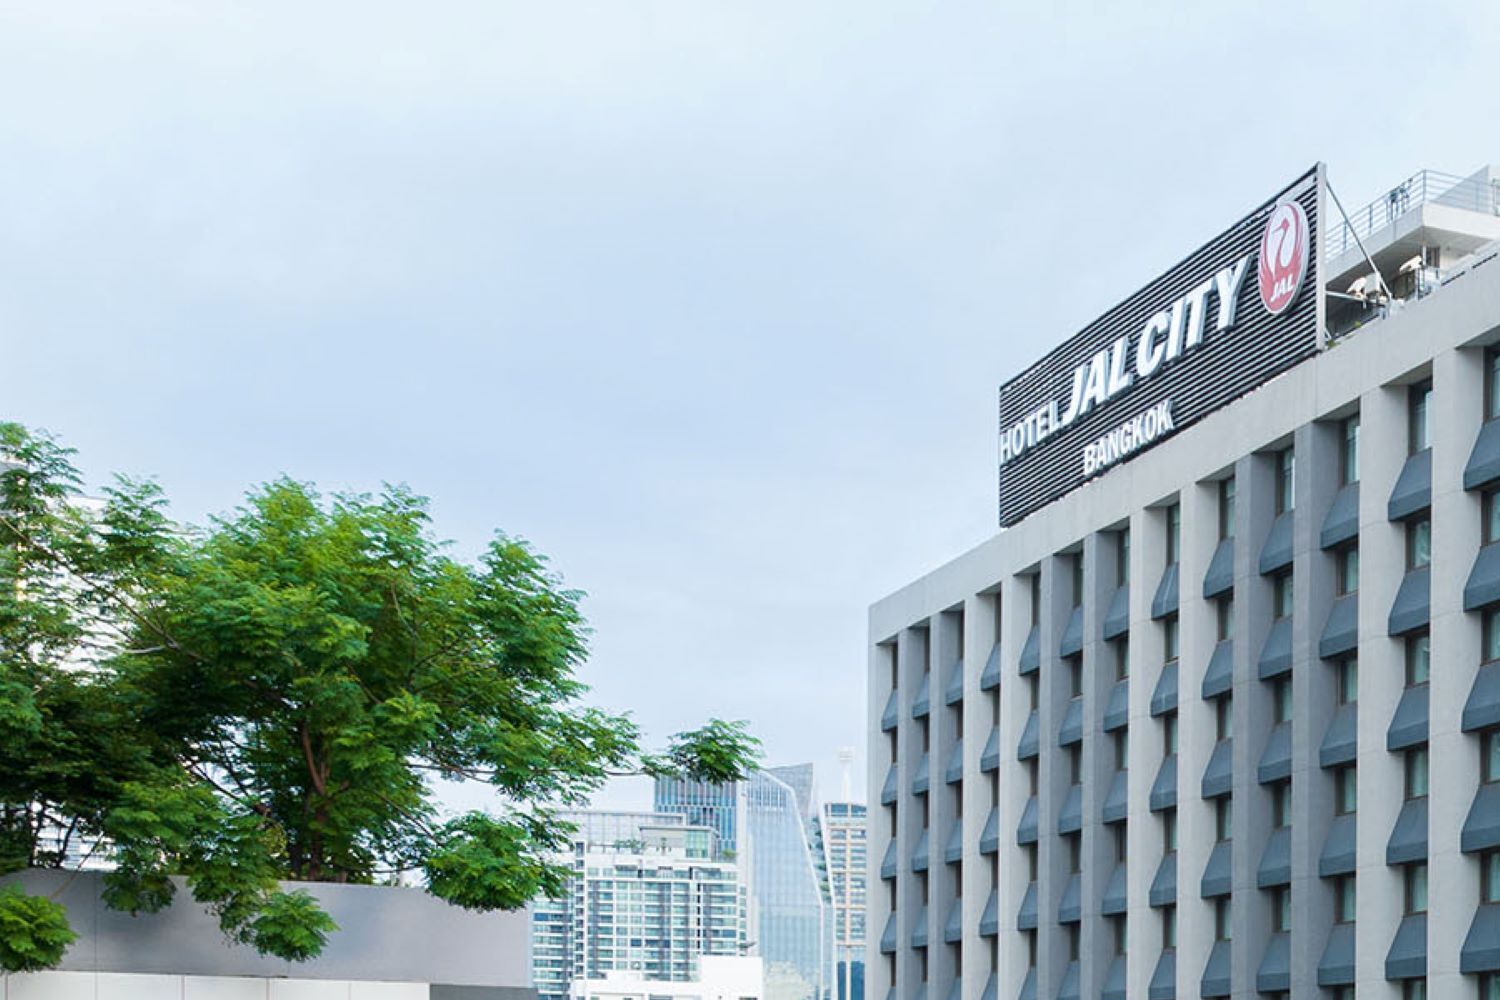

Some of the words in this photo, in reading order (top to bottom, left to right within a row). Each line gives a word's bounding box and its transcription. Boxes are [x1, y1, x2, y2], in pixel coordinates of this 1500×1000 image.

[1269, 273, 1294, 303] JAL
[999, 400, 1061, 464] HOTEL
[1062, 335, 1134, 425] JAL
[1136, 254, 1253, 377] CITY
[1083, 398, 1175, 476] BANGKOK
